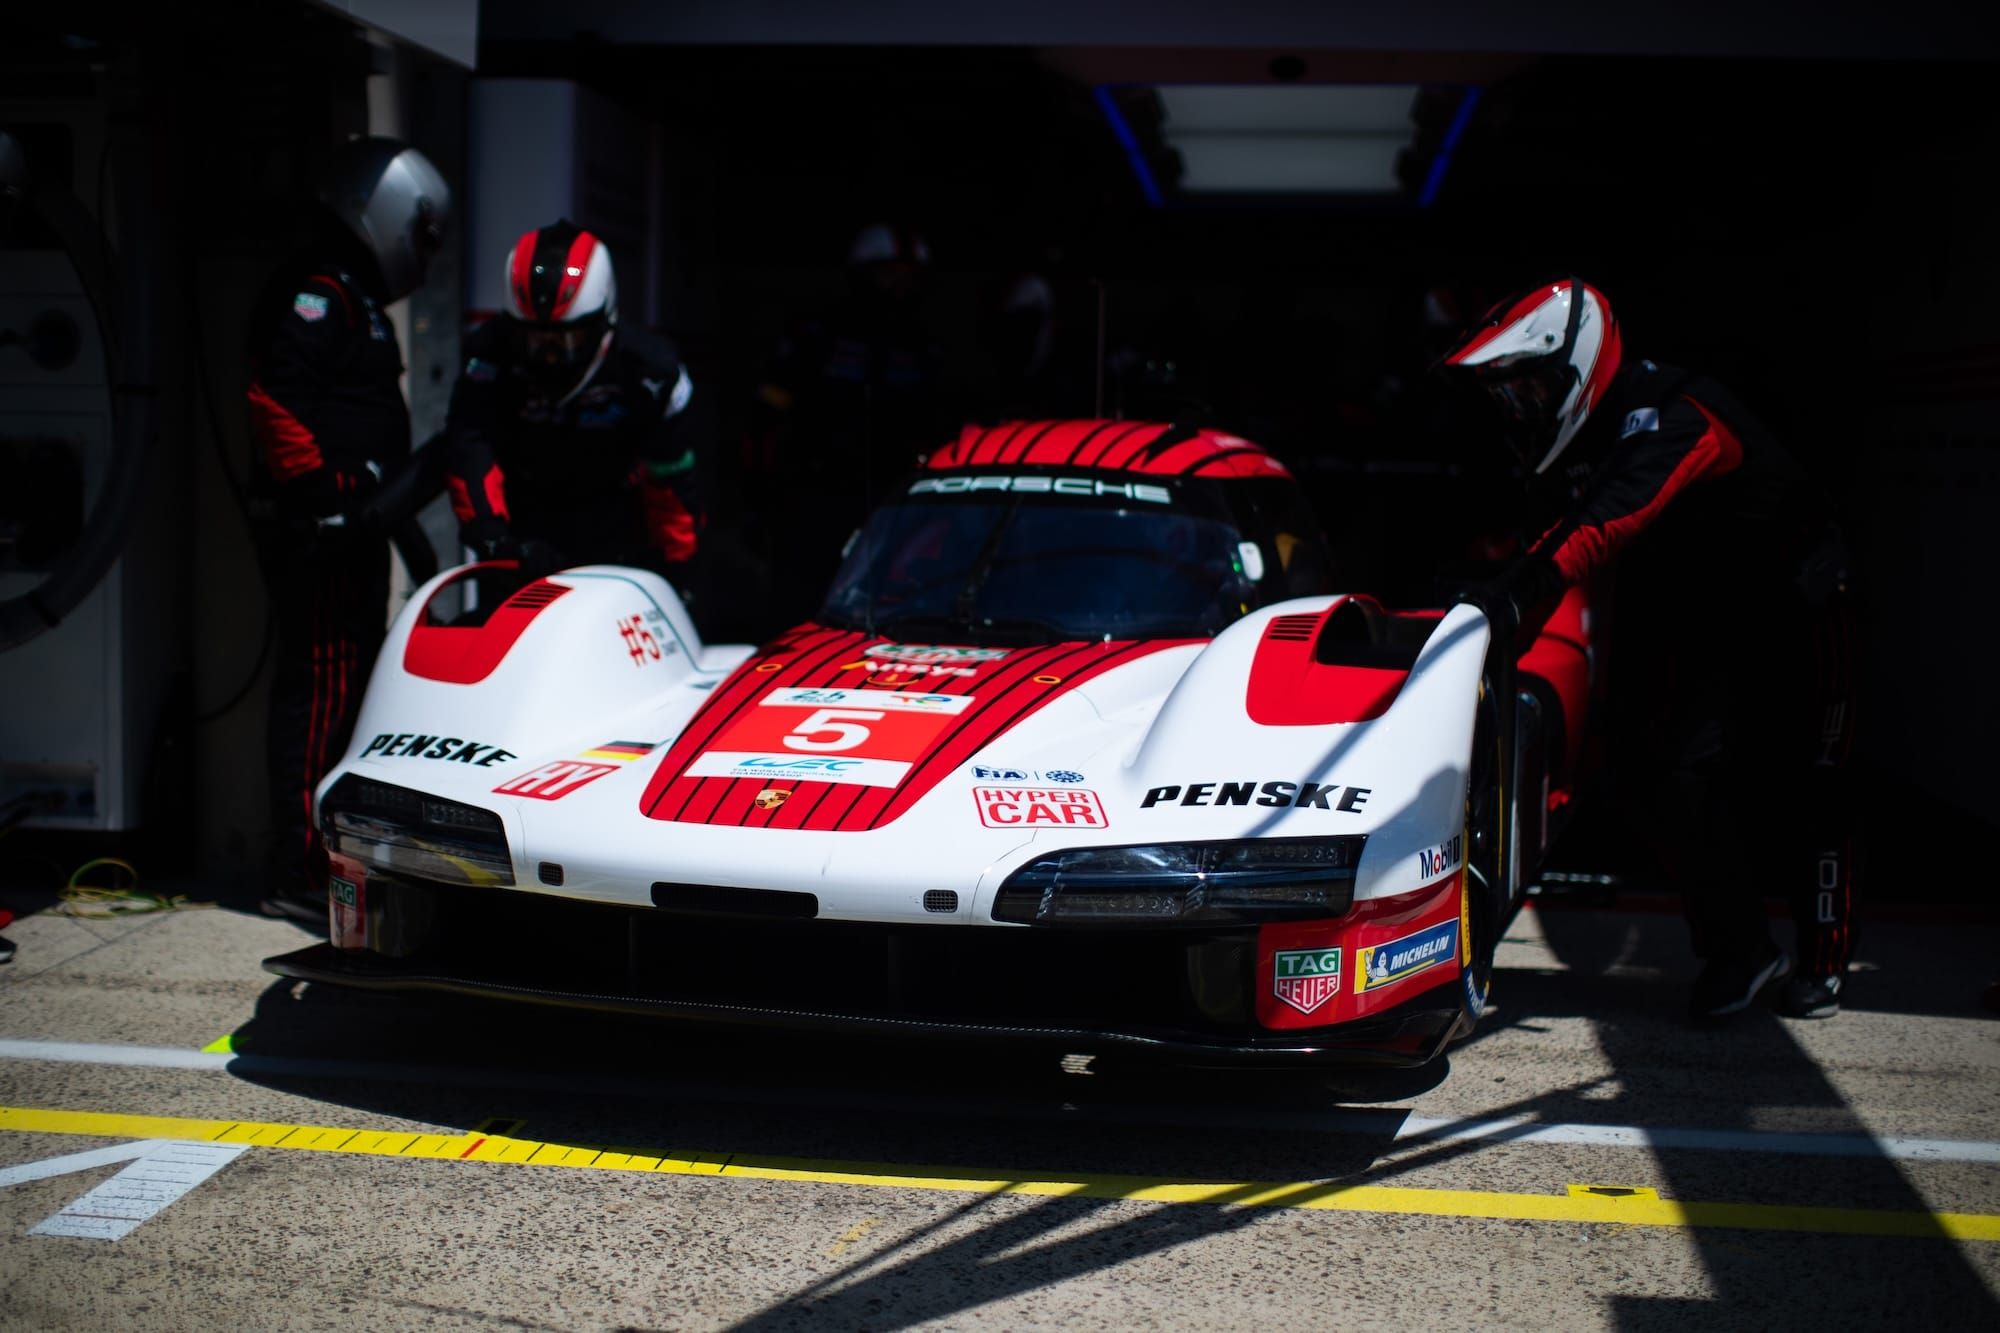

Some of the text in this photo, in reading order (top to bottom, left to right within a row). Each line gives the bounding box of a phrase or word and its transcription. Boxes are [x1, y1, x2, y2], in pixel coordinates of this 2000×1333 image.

[908, 475, 1171, 504] PORSCHE
[616, 613, 662, 668] #5
[782, 708, 886, 752] 5
[359, 733, 518, 767] PENSKE
[738, 756, 864, 772] WEC
[975, 767, 1023, 779] FIA
[983, 790, 1090, 803] HYPER
[1139, 781, 1371, 814] PENSKE
[988, 803, 1097, 824] CAR
[1419, 839, 1452, 880] Mobil
[1281, 953, 1336, 974] TAG
[1390, 935, 1449, 971] MICHELIN
[1278, 976, 1337, 1008] HEUER
